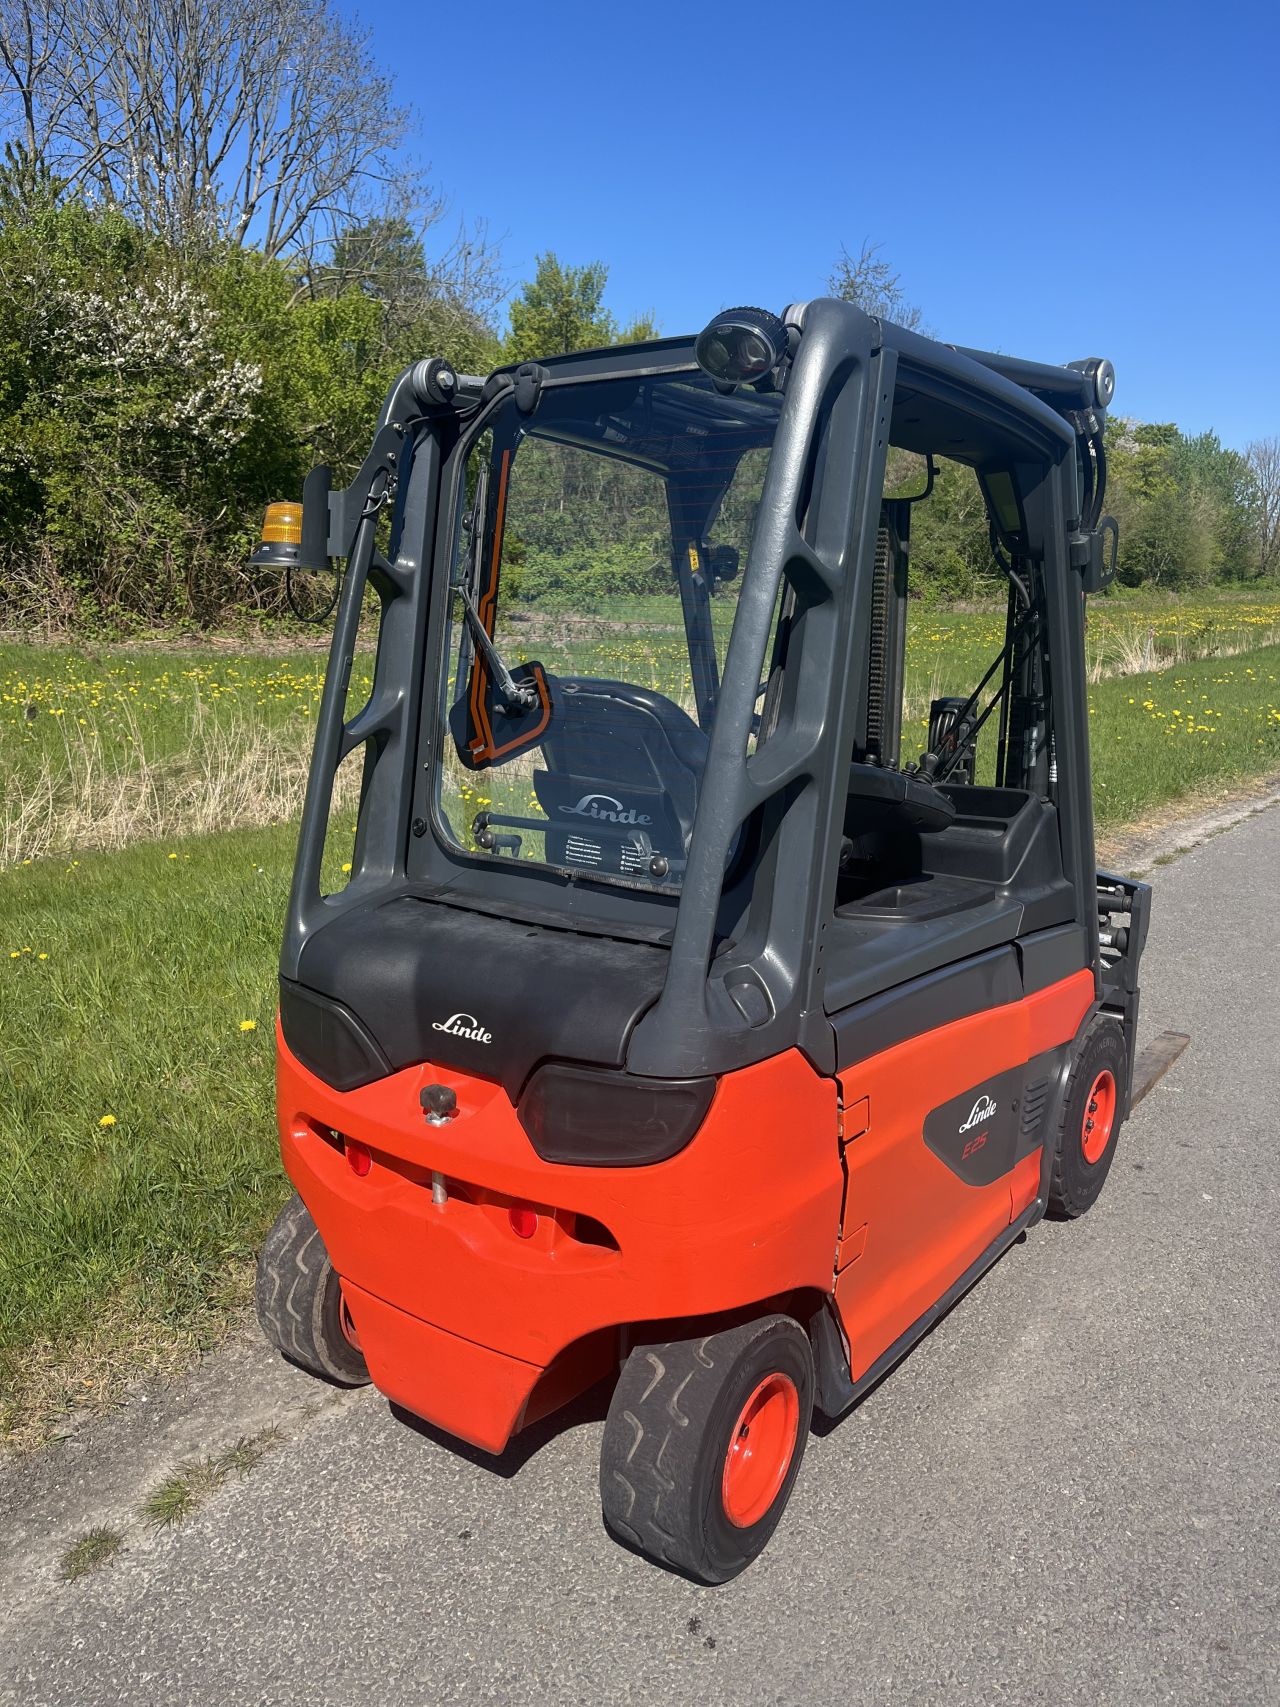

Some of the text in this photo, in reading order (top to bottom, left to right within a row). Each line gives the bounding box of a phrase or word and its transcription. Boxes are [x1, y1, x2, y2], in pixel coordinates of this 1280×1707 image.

[558, 794, 653, 825] Linde
[432, 1013, 492, 1044] Linde
[959, 1095, 997, 1133] Linde
[961, 1132, 989, 1160] E25
